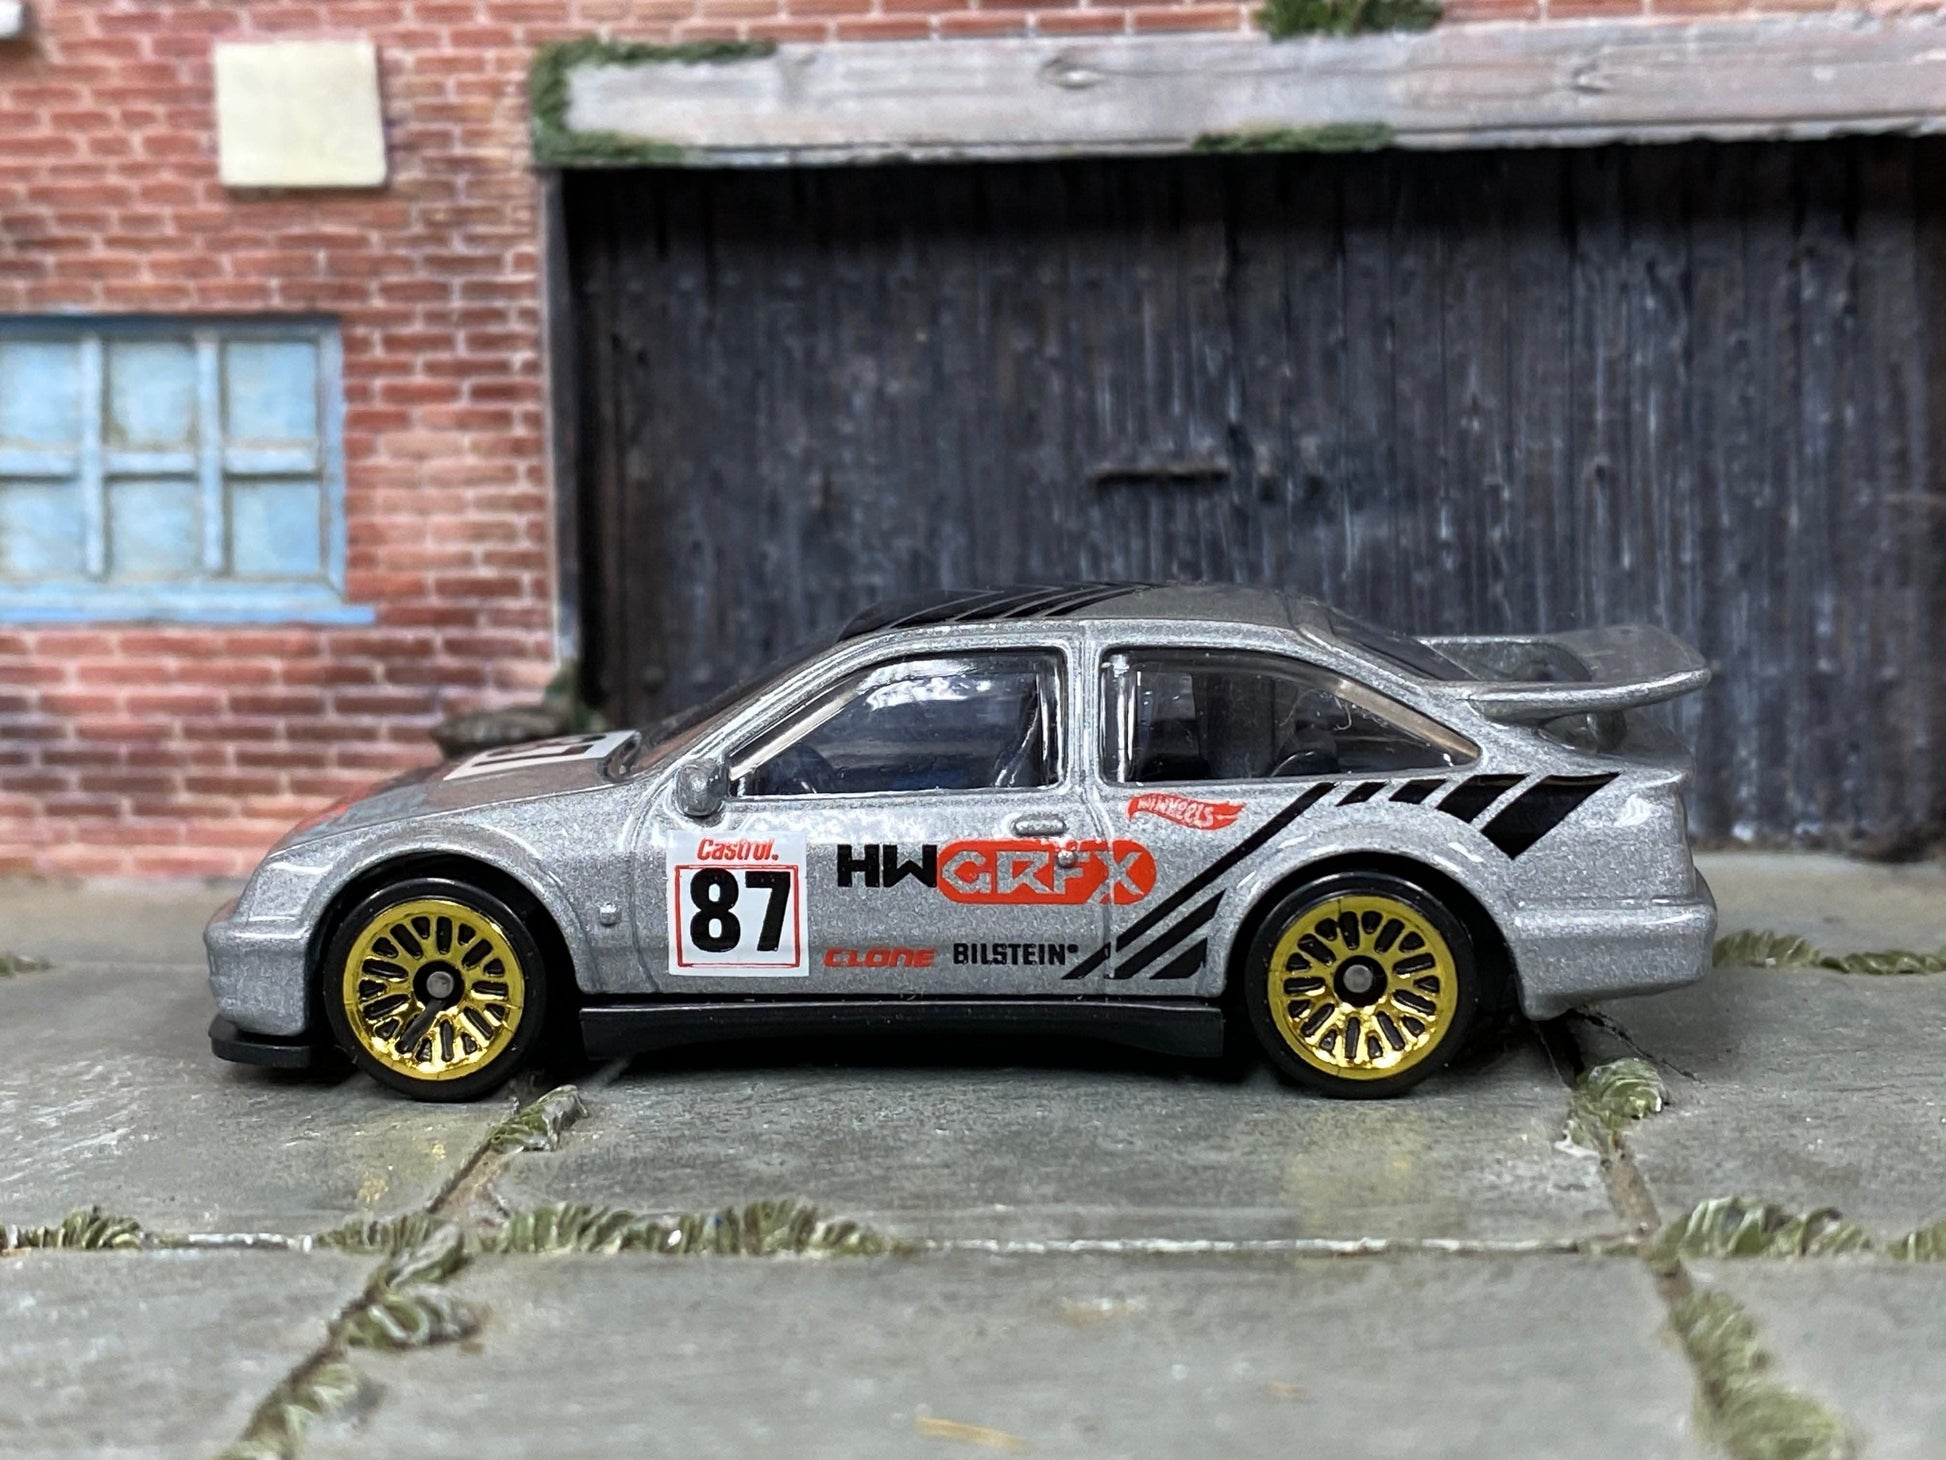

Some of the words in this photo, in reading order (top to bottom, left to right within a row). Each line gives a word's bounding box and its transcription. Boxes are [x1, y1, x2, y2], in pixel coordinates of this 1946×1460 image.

[690, 867, 791, 953] 87
[823, 946, 937, 969] CLONE
[953, 942, 1067, 967] BILSTEIN
